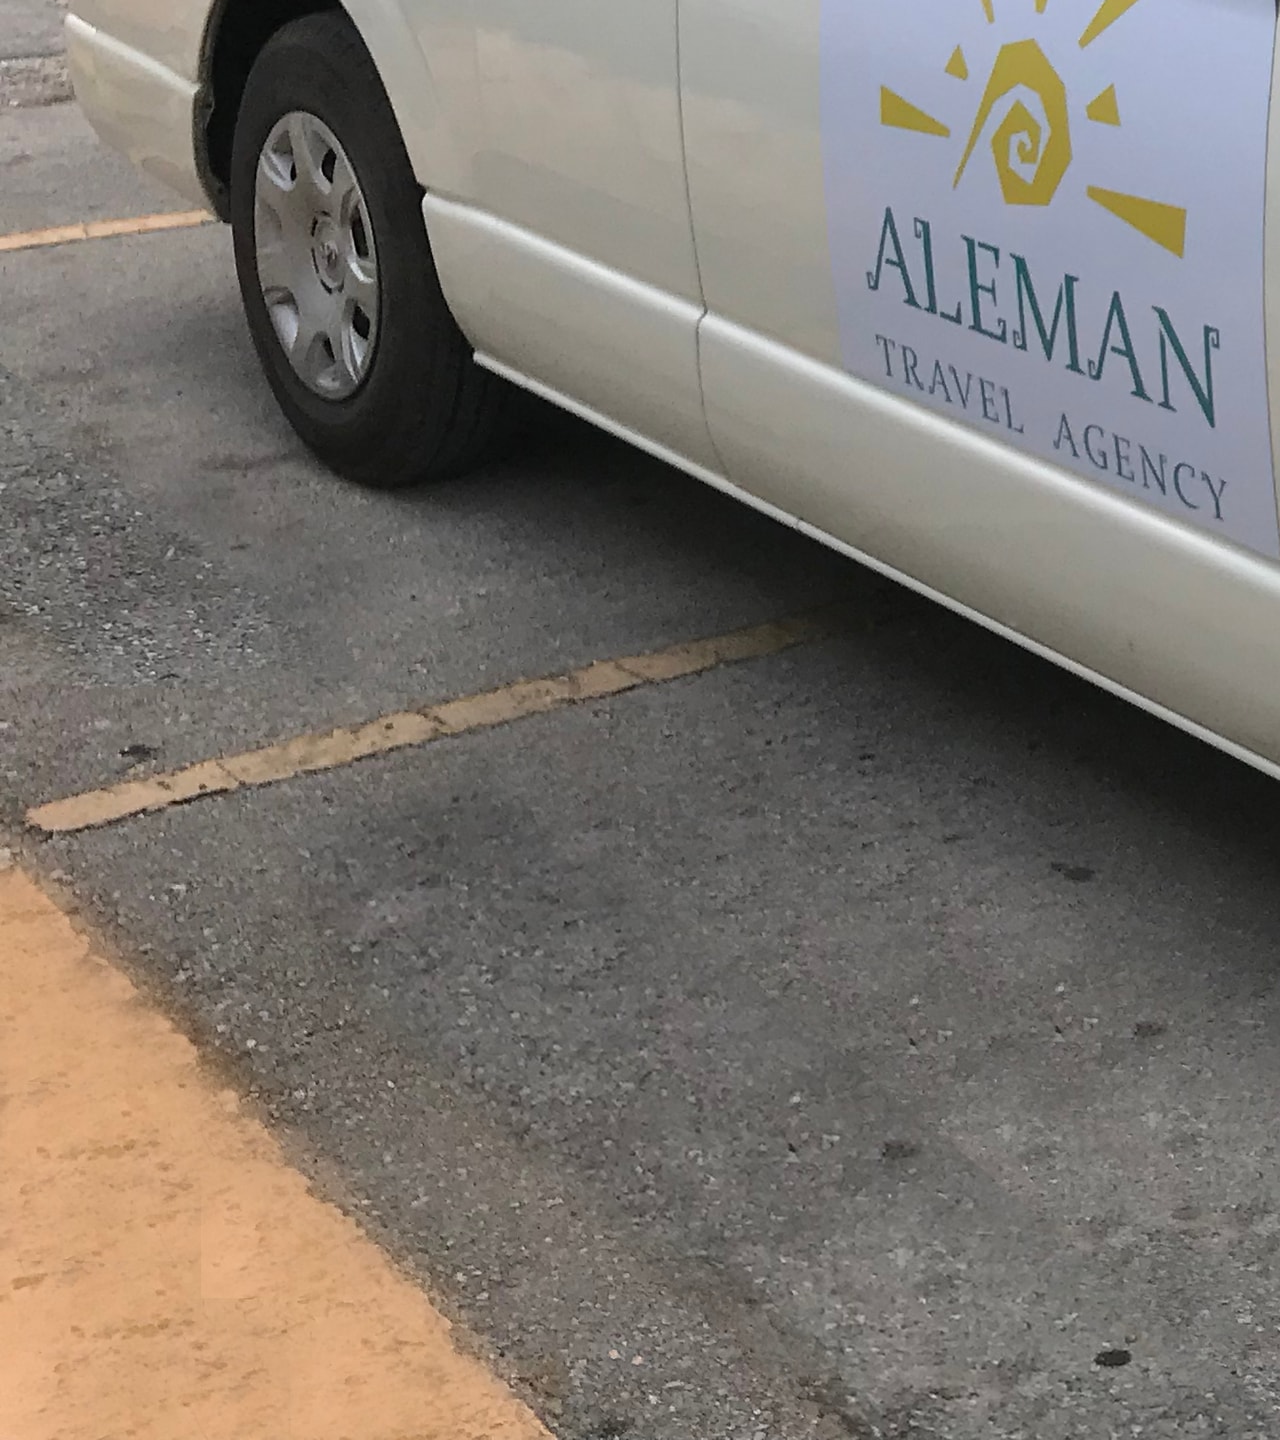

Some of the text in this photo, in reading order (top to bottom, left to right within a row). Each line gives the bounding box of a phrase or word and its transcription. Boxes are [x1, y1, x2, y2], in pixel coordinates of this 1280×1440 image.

[866, 205, 1220, 429] ALEMAN
[875, 333, 1227, 522] TRAVEL AGENCY
